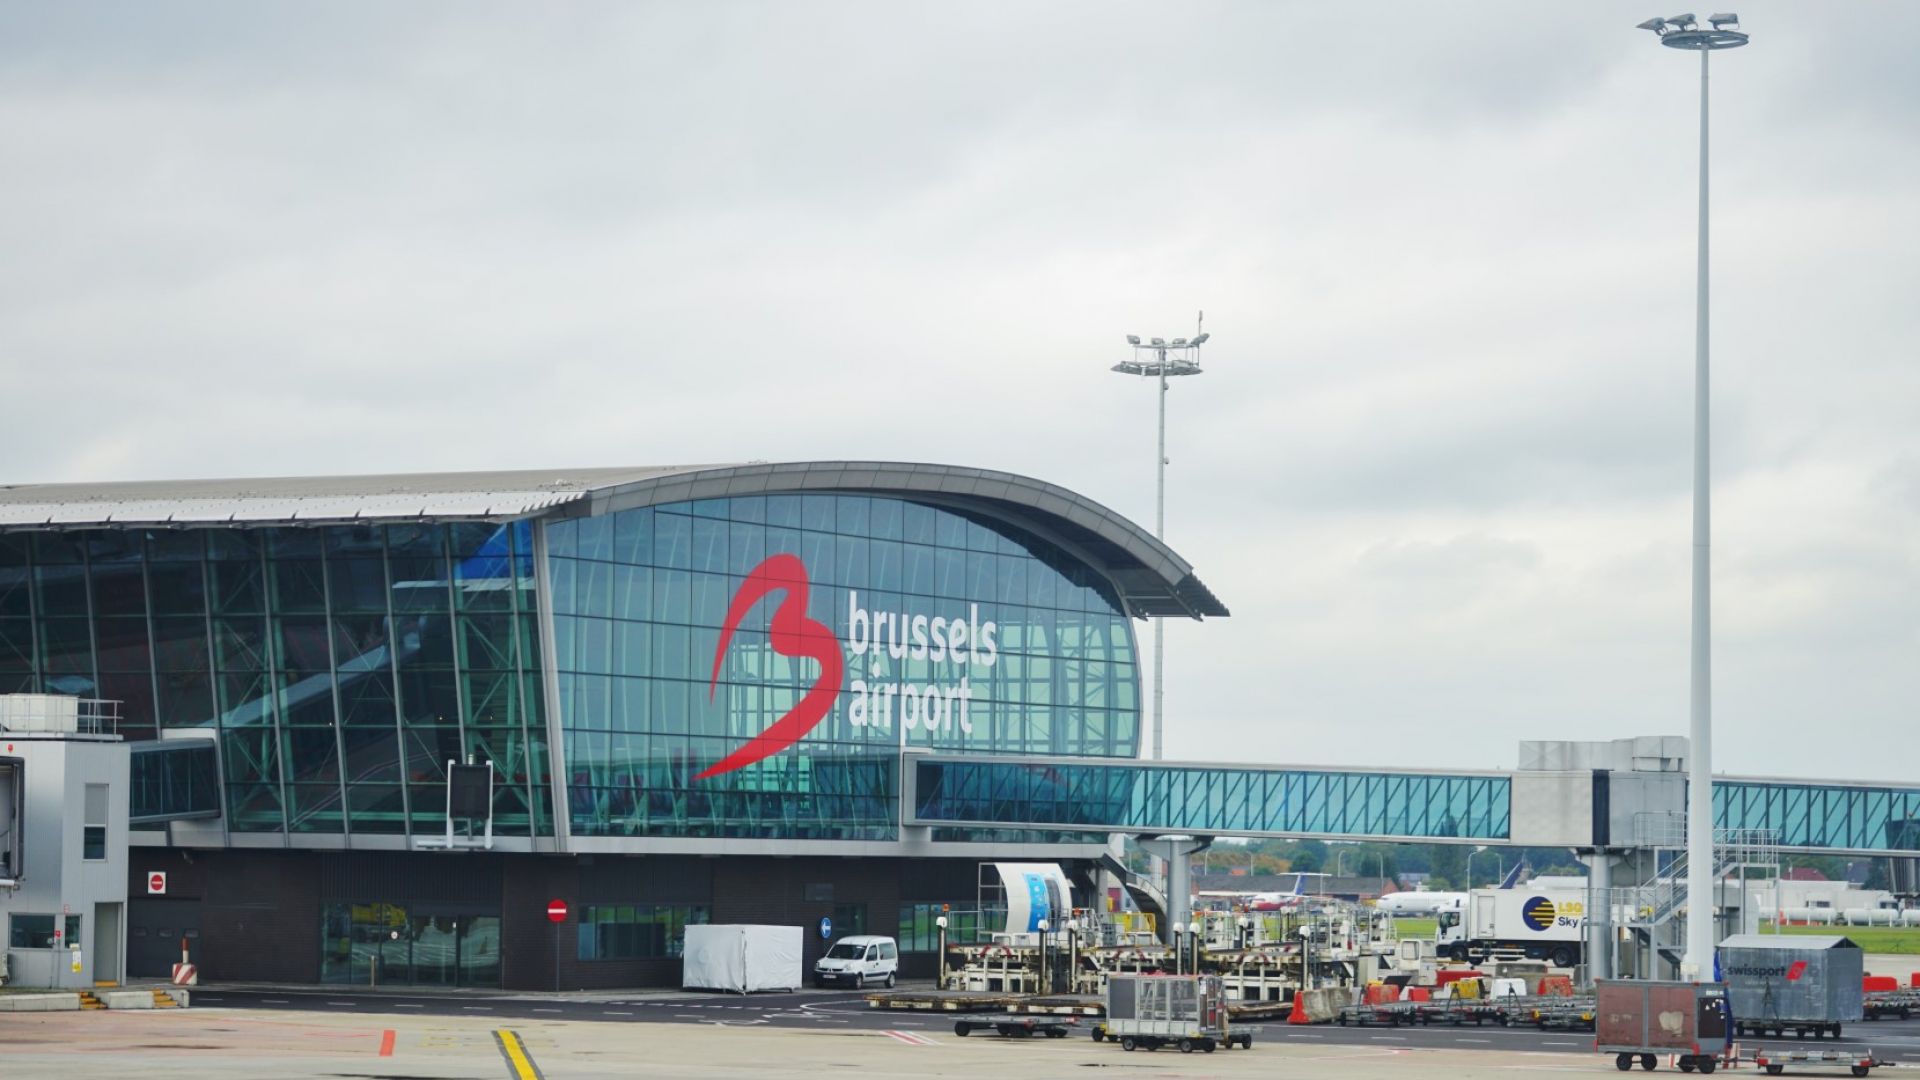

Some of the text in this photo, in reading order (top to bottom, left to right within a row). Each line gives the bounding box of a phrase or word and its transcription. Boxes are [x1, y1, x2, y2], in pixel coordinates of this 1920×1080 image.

[850, 590, 997, 666] brussels
[849, 662, 972, 747] airport
[1558, 916, 1578, 928] Sky
[1728, 963, 1786, 978] swissport
